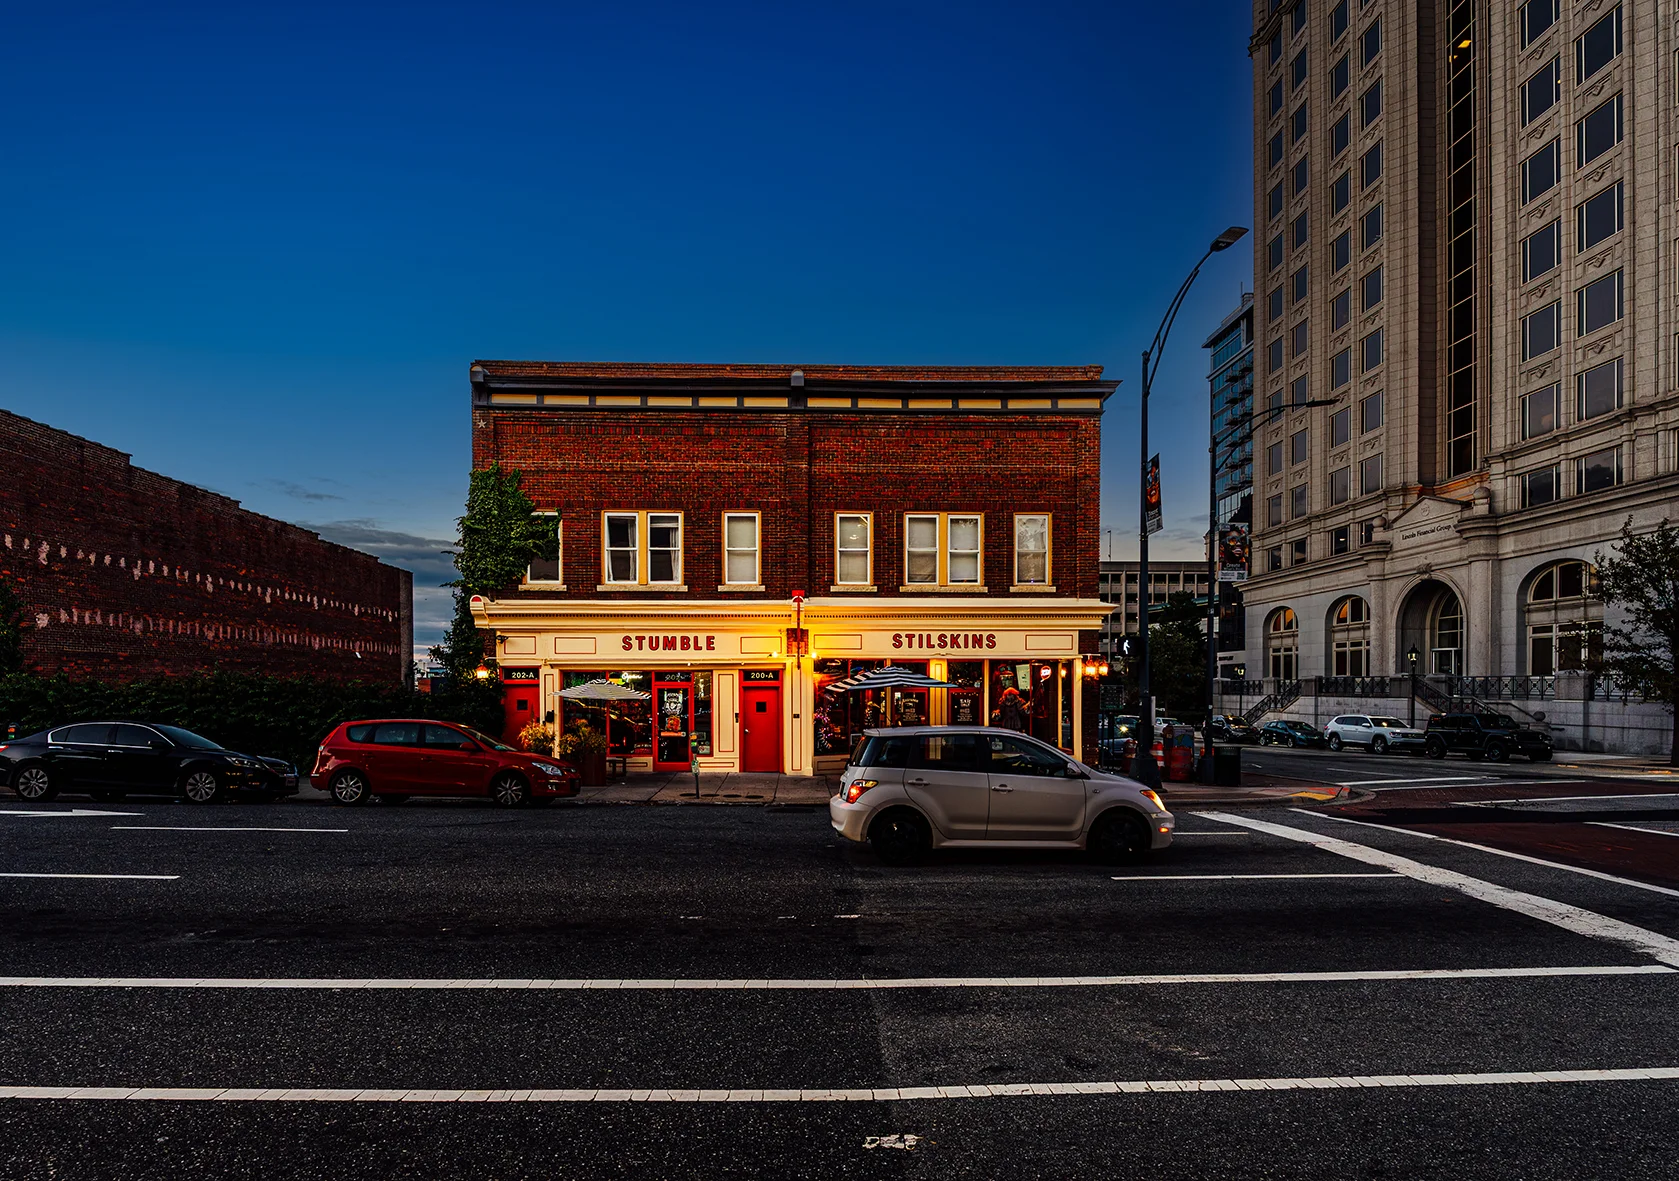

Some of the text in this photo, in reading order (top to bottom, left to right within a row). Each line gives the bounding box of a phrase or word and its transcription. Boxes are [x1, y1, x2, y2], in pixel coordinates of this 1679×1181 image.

[1401, 524, 1451, 540] Lincoln Financial Group
[621, 635, 715, 651] STUMBLE
[892, 633, 996, 649] STILSKINS
